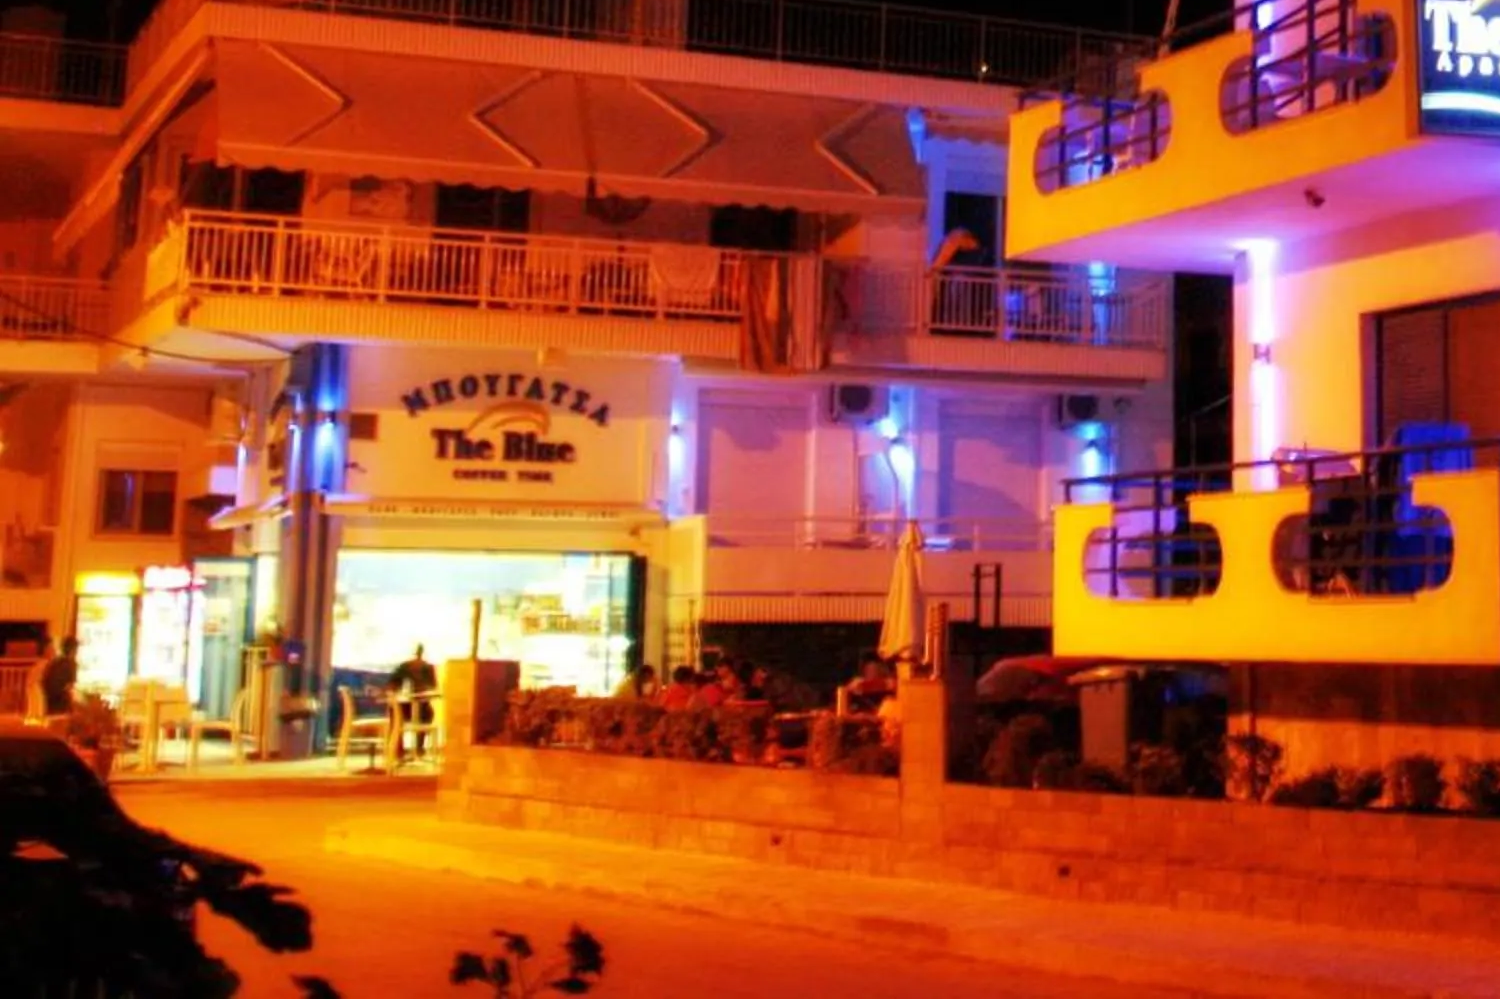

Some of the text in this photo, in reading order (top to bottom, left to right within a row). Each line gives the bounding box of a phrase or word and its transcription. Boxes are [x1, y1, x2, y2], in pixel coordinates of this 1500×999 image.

[401, 374, 610, 428] ΜΠΟΥΓΑΤΣΑ
[431, 428, 575, 464] The Blue
